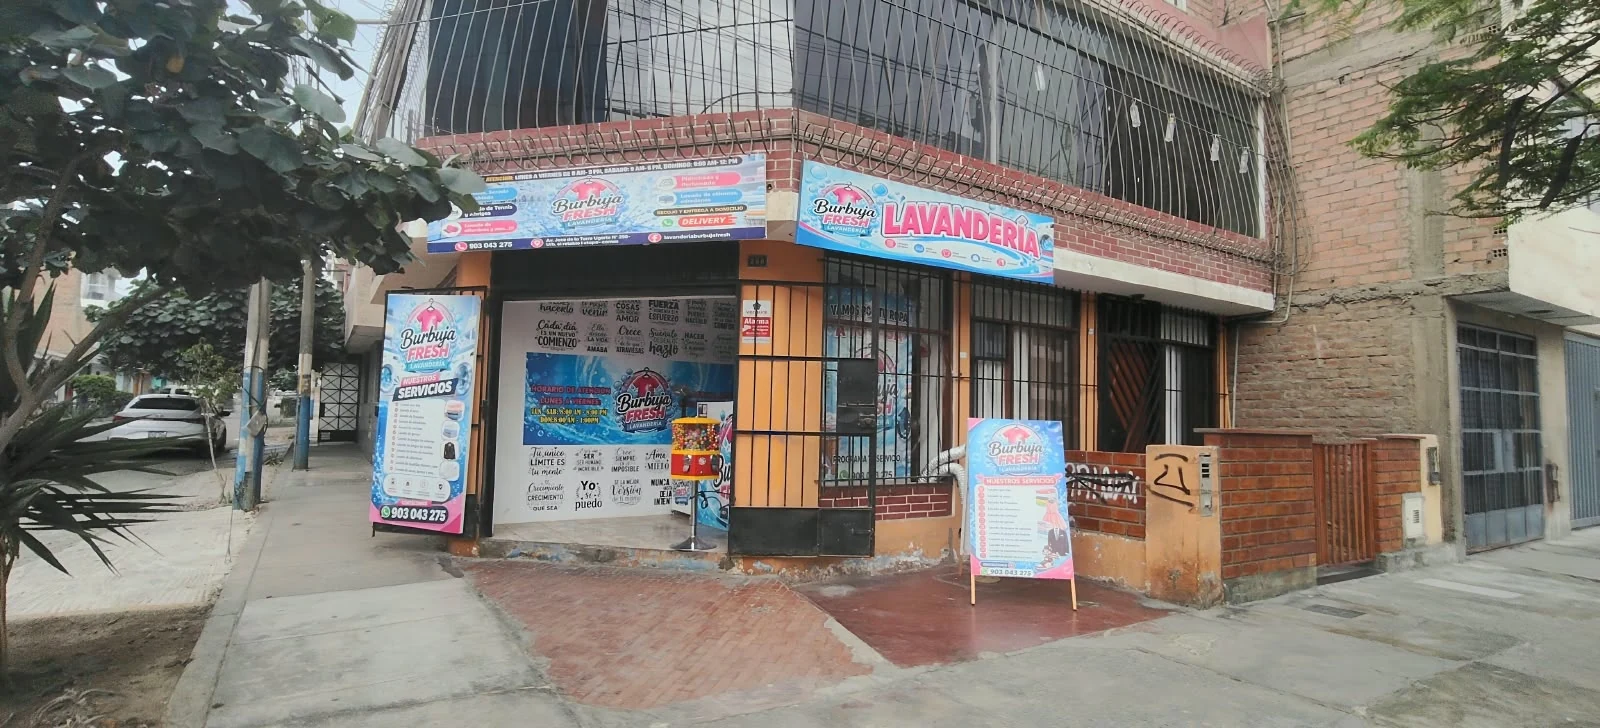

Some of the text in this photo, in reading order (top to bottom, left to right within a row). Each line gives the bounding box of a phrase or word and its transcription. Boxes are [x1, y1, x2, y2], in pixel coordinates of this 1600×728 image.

[552, 194, 622, 214] Burbuja
[814, 198, 876, 219] Burbuja
[563, 208, 616, 221] FRESH
[682, 216, 726, 225] DELIVERY
[824, 214, 870, 228] FRESH
[884, 203, 1040, 259] LAVANDERÍA
[616, 302, 640, 311] COSAS
[648, 300, 680, 310] FUERZA
[582, 308, 608, 317] venir
[616, 314, 640, 323] AMOR
[648, 312, 679, 322] ESFUERZO
[538, 320, 560, 330] Cada
[618, 325, 642, 336] Crece
[400, 326, 456, 350] Burbuja
[538, 336, 578, 348] COMIENZO
[408, 344, 449, 361] FRESH
[648, 340, 679, 358] hazlo
[402, 374, 437, 384] NUESTROS
[398, 380, 452, 399] SERVICIOS
[532, 385, 564, 393] HORARIO
[617, 392, 671, 413] Burbuja
[625, 408, 665, 423] FRESH
[988, 441, 1042, 456] Burbuja
[556, 458, 565, 466] ES
[998, 454, 1038, 465] FRESH
[580, 480, 596, 490] Yo
[650, 478, 670, 486] NUNCA
[575, 498, 602, 511] puedo
[392, 507, 446, 522] 903 043 275
